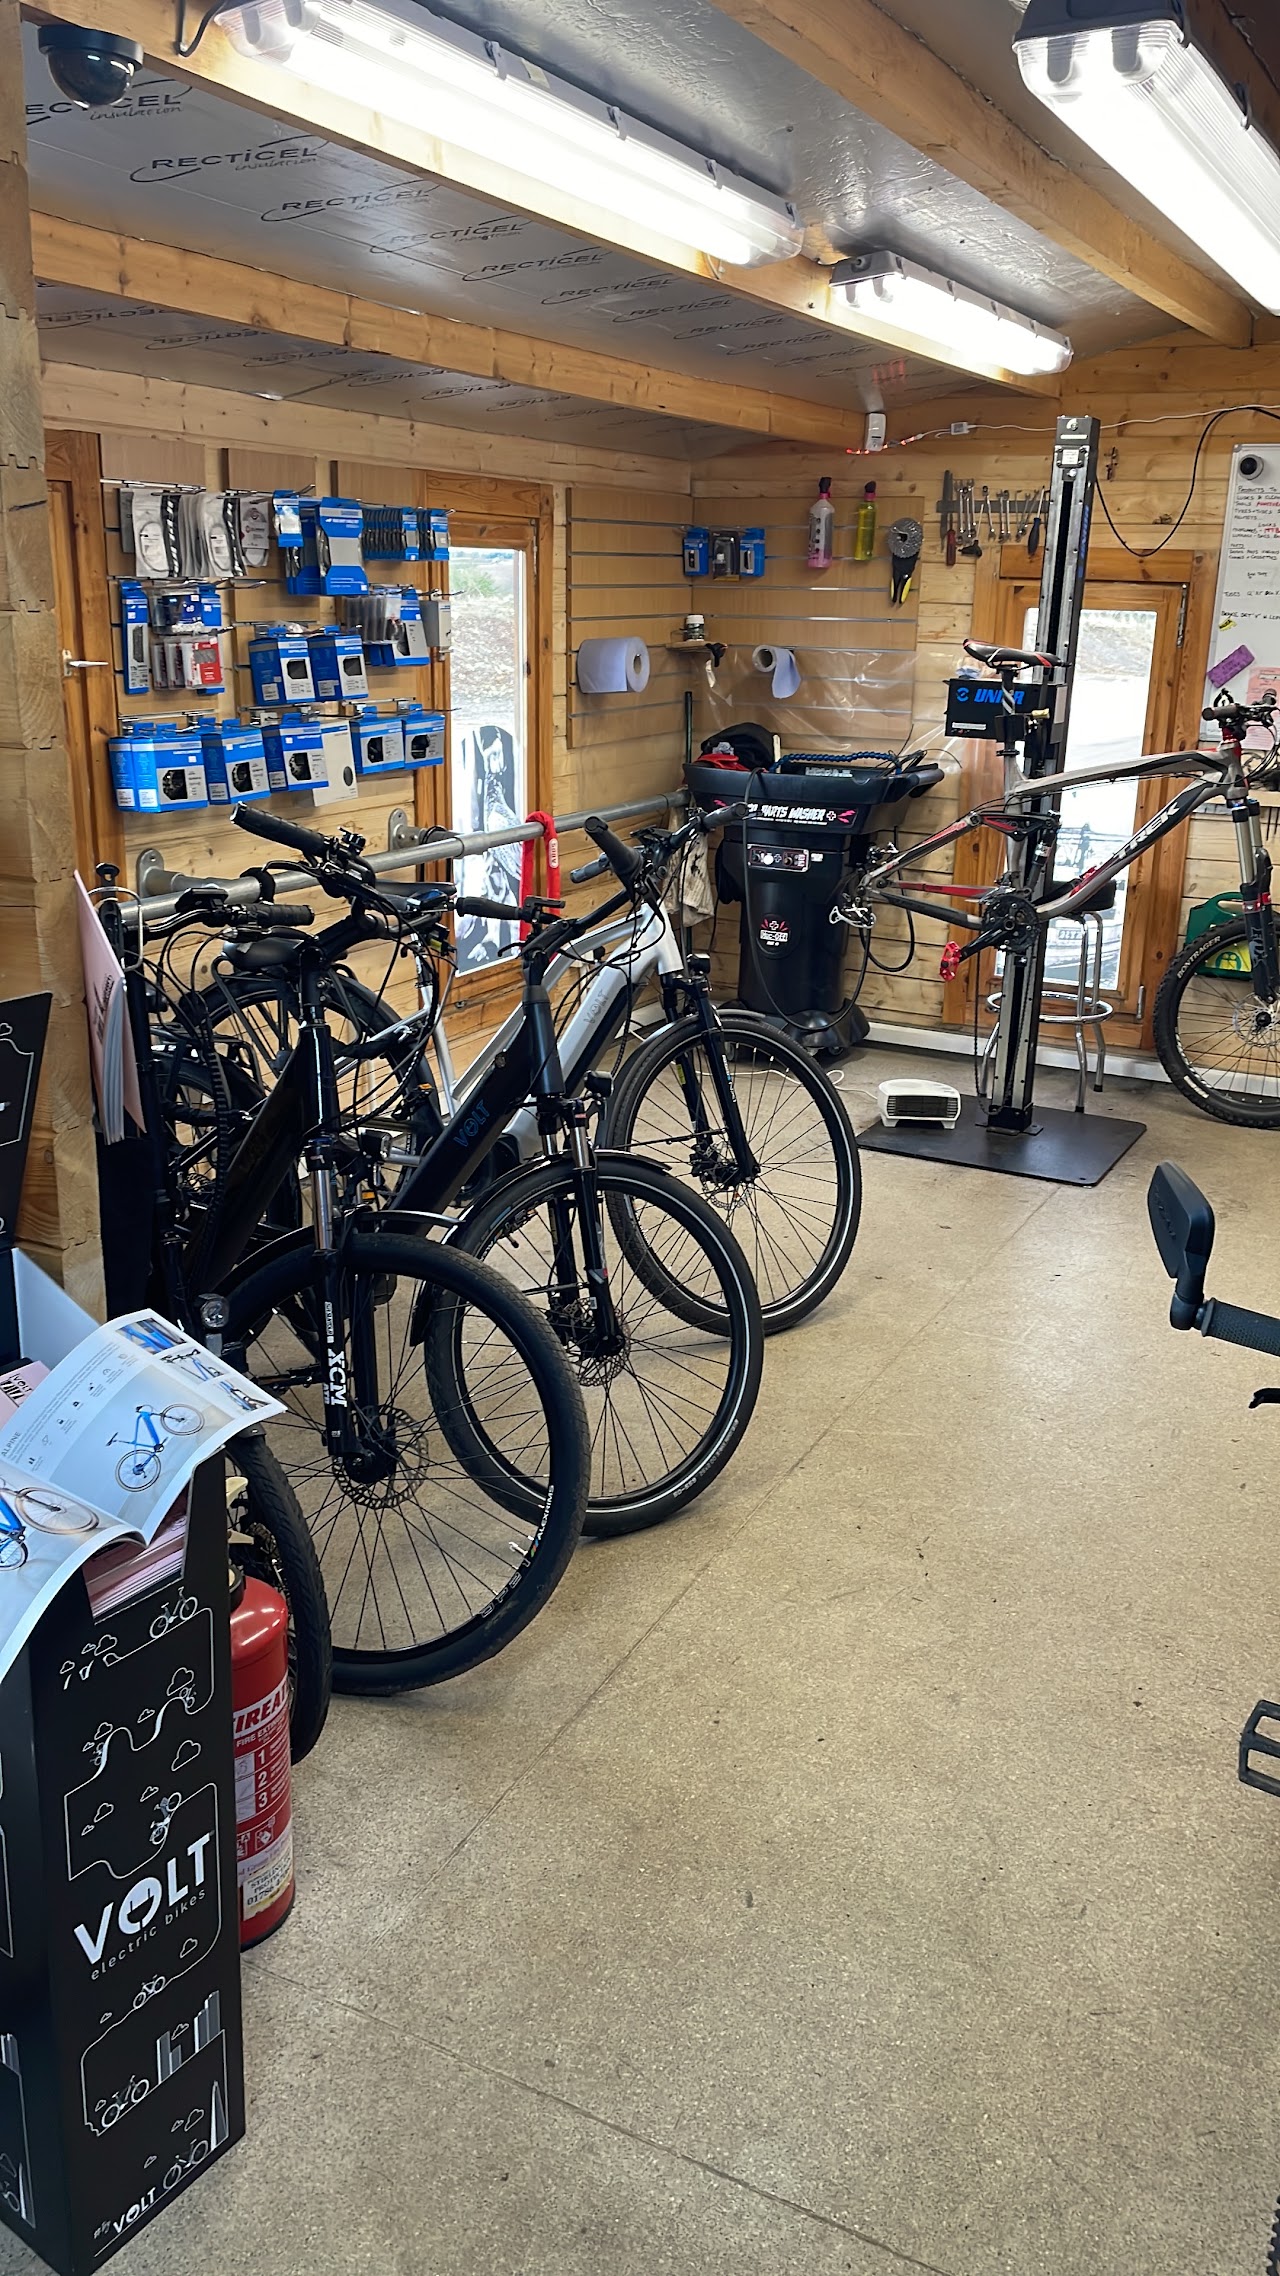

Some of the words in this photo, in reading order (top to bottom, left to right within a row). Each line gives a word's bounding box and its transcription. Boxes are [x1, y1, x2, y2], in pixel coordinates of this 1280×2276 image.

[761, 804, 789, 819] PARTS
[787, 807, 827, 822] WASHER
[1112, 801, 1181, 860] TREK
[1176, 936, 1221, 979] BONTRAGER
[582, 991, 611, 1026] VOLT
[453, 1100, 491, 1149] VOLT
[328, 1348, 348, 1408] XCM
[1, 1431, 22, 1457] ALPINE
[537, 1484, 555, 1541] ALEXRIMS
[236, 1733, 257, 1748] FIRE
[258, 1749, 266, 1765] 1
[258, 1771, 268, 1788] 2
[258, 1791, 268, 1808] 3
[74, 1832, 211, 1965] VOLT
[90, 1925, 158, 1981] electric
[164, 1888, 207, 1926] bikes
